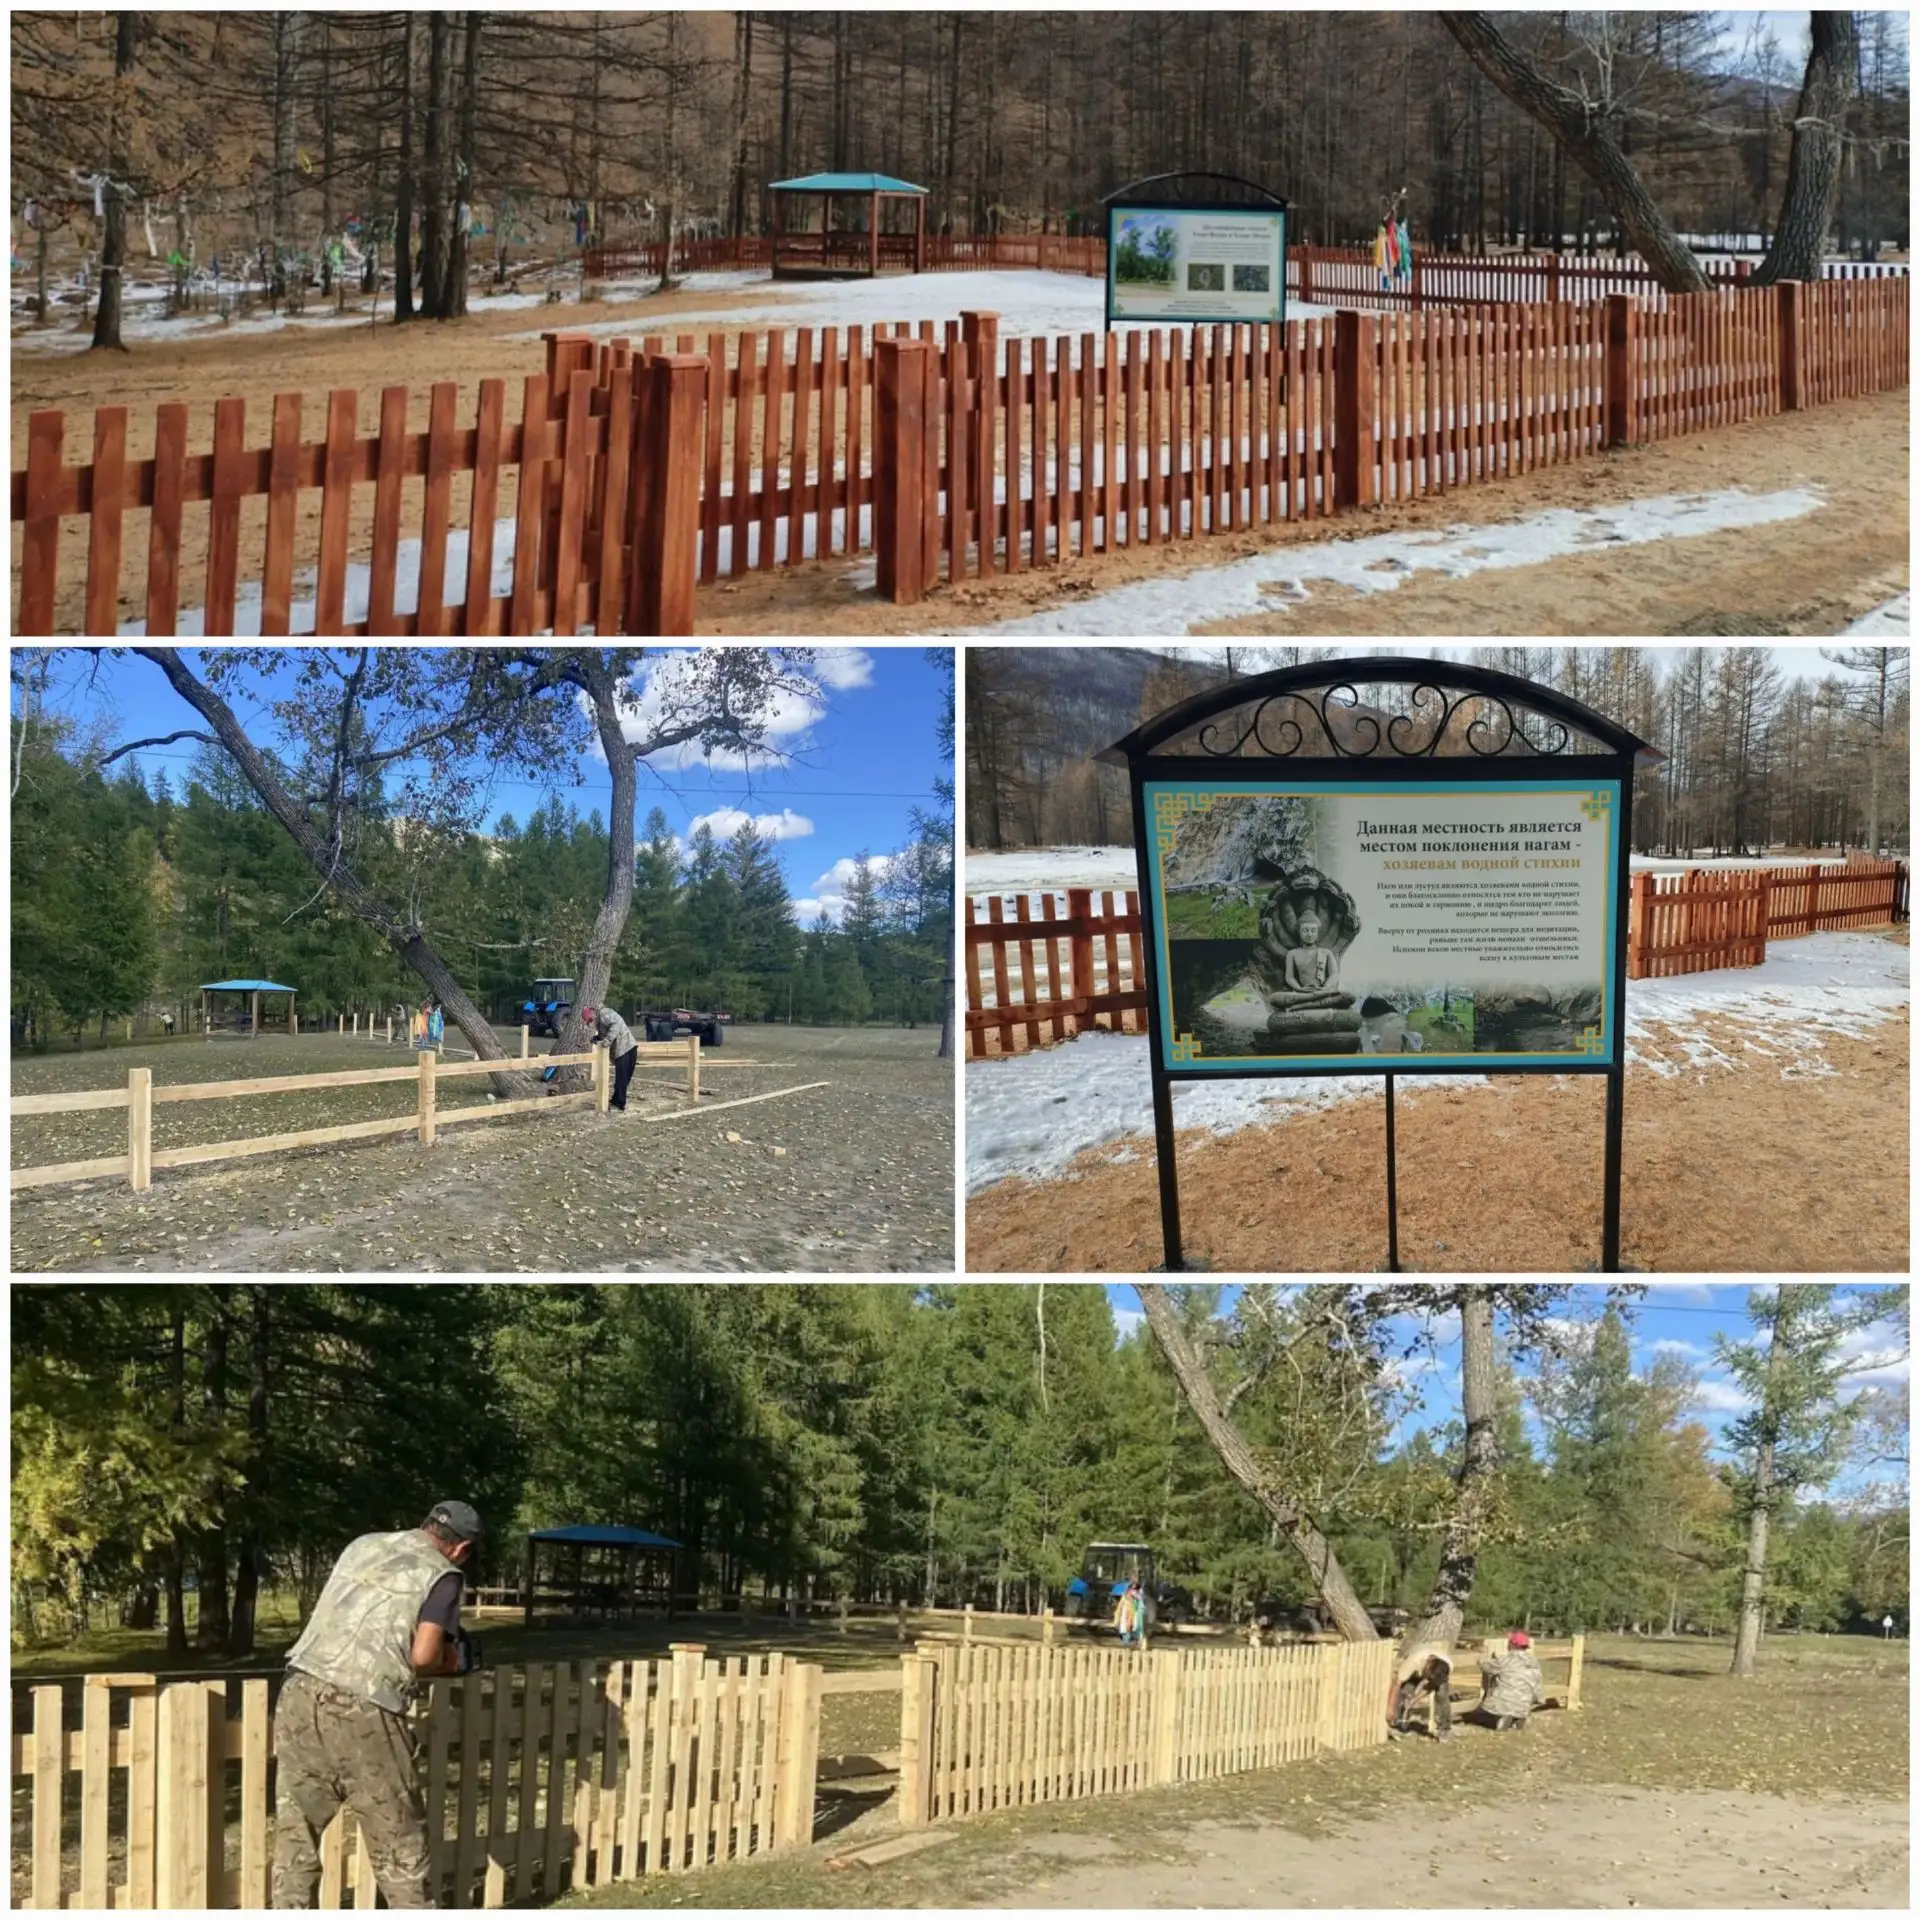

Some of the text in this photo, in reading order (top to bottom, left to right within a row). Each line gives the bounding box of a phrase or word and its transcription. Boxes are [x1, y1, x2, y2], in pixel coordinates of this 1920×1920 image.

[1357, 821, 1582, 837] Данная местность является
[1360, 841, 1417, 852] местом
[1421, 840, 1519, 852] поклонения
[1524, 840, 1570, 852] нагам
[1383, 856, 1581, 871] хозяевам водной стихии
[1377, 882, 1397, 890] Наги
[1521, 881, 1550, 889] водной
[1408, 891, 1461, 899] благосклонно
[1543, 891, 1580, 899] нарушает
[1456, 911, 1488, 919] которые
[1500, 910, 1539, 919] нарушают
[1491, 927, 1519, 935] пещера
[1429, 937, 1458, 945] раньше
[1392, 945, 1426, 953] Испокон
[1483, 946, 1534, 954] уважительно
